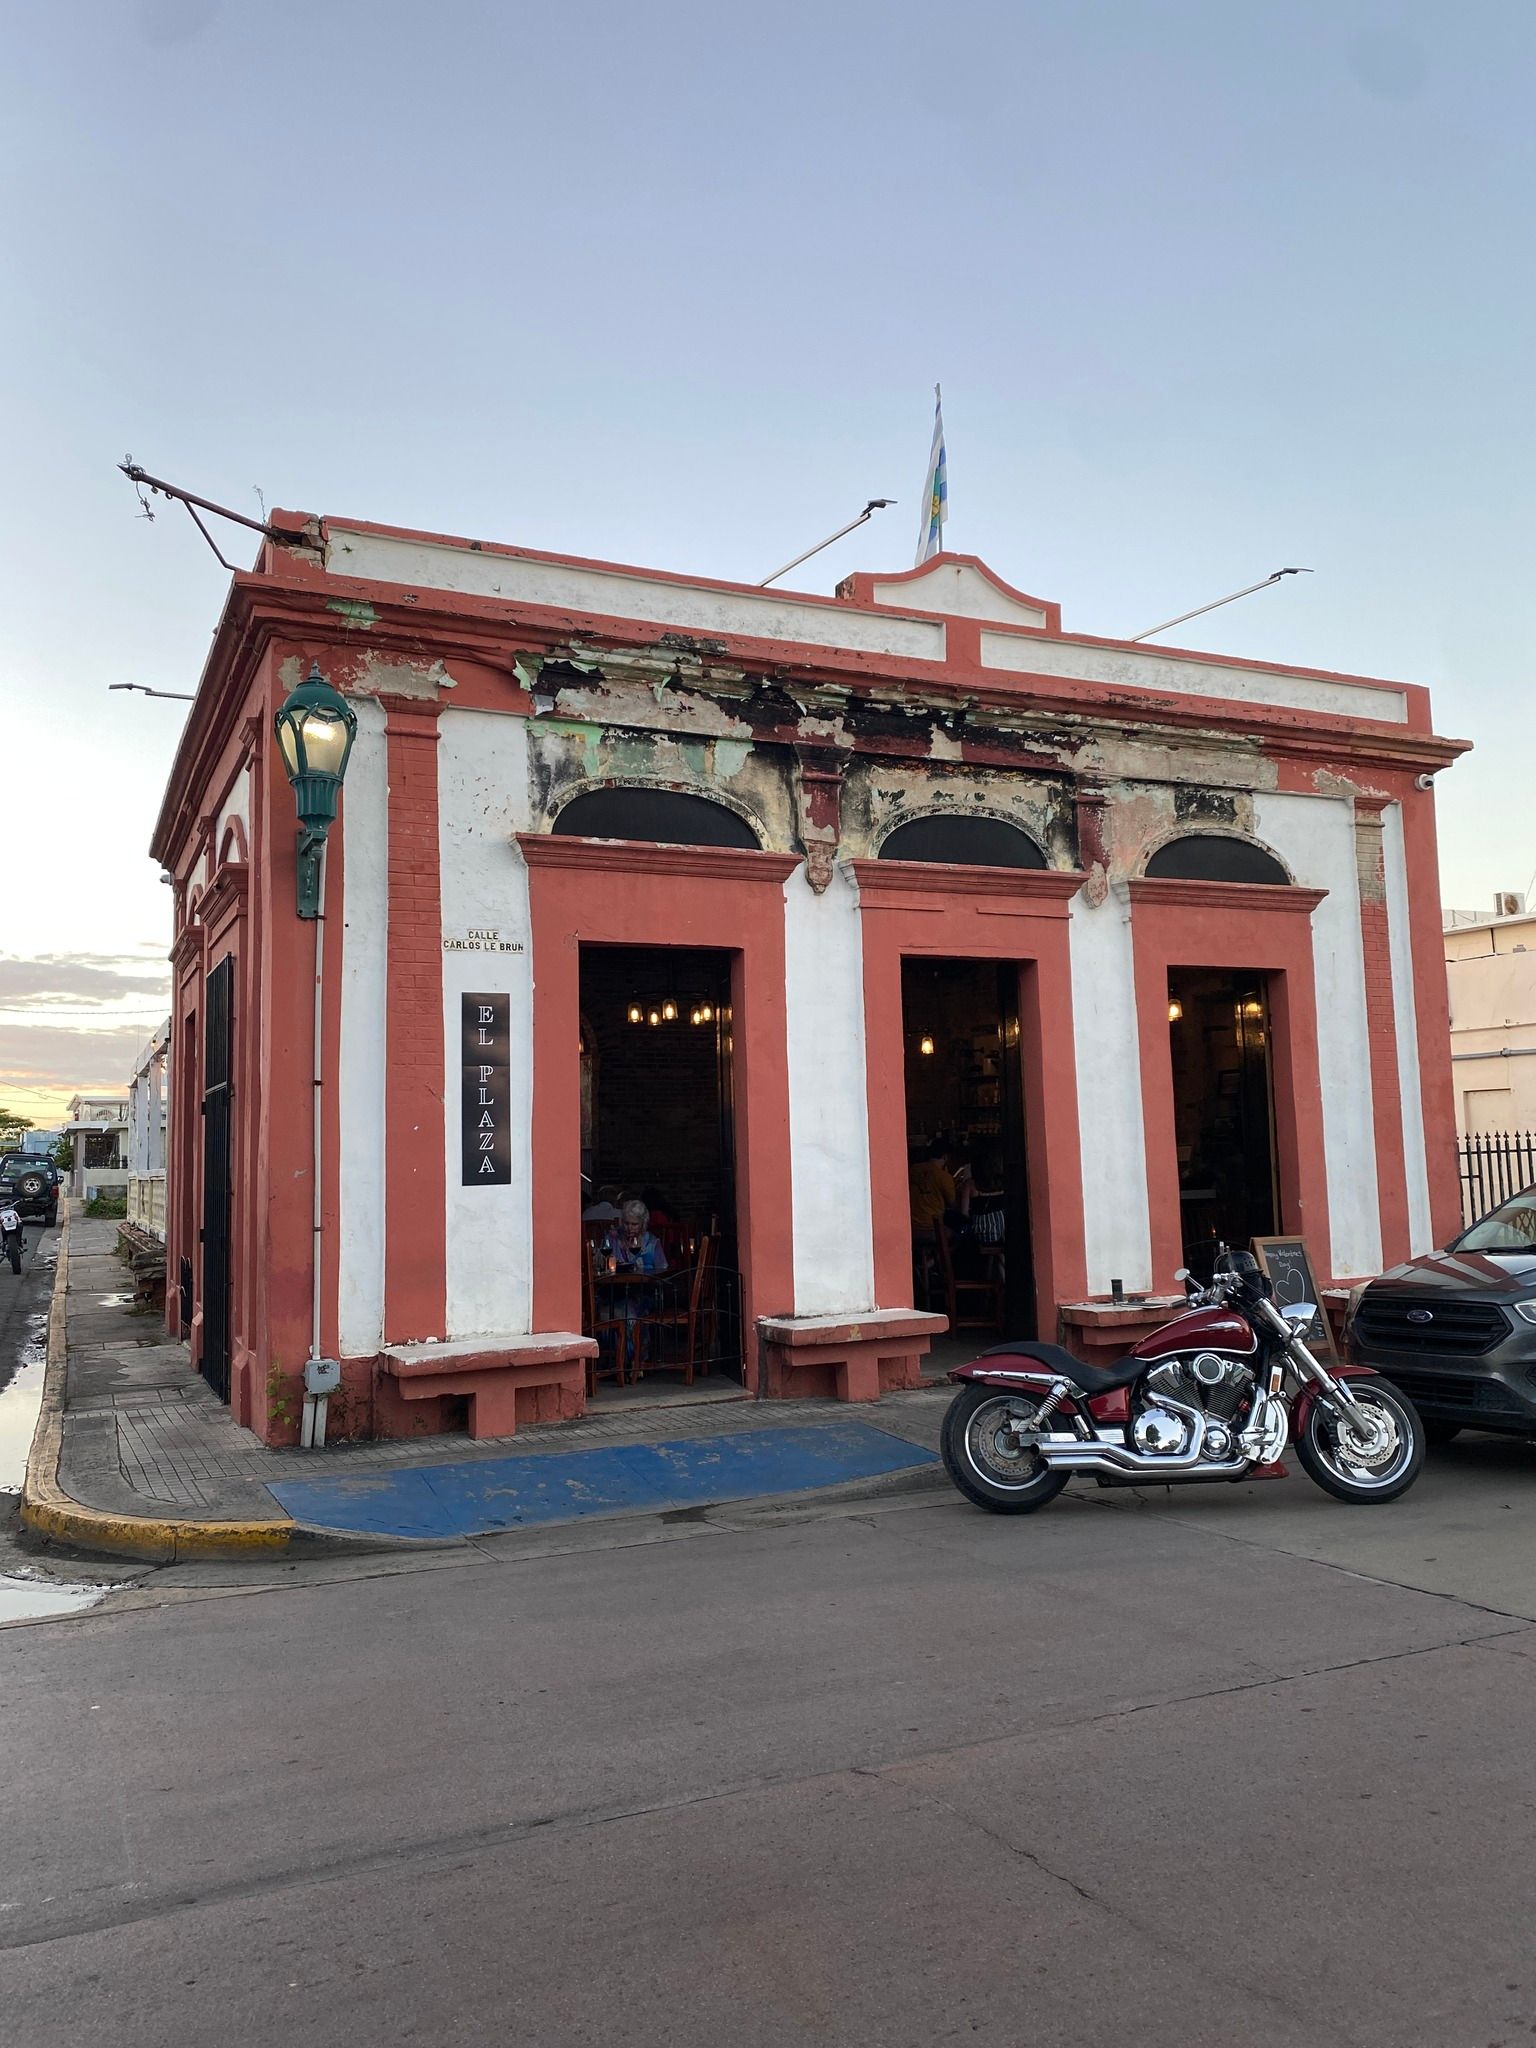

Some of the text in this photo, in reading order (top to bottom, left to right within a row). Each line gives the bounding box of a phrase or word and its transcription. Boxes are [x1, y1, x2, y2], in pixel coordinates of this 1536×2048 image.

[468, 931, 499, 940] CALLE
[443, 940, 481, 950] CARLOS
[484, 942, 496, 951] LE
[478, 1006, 495, 1174] EL PLAZA
